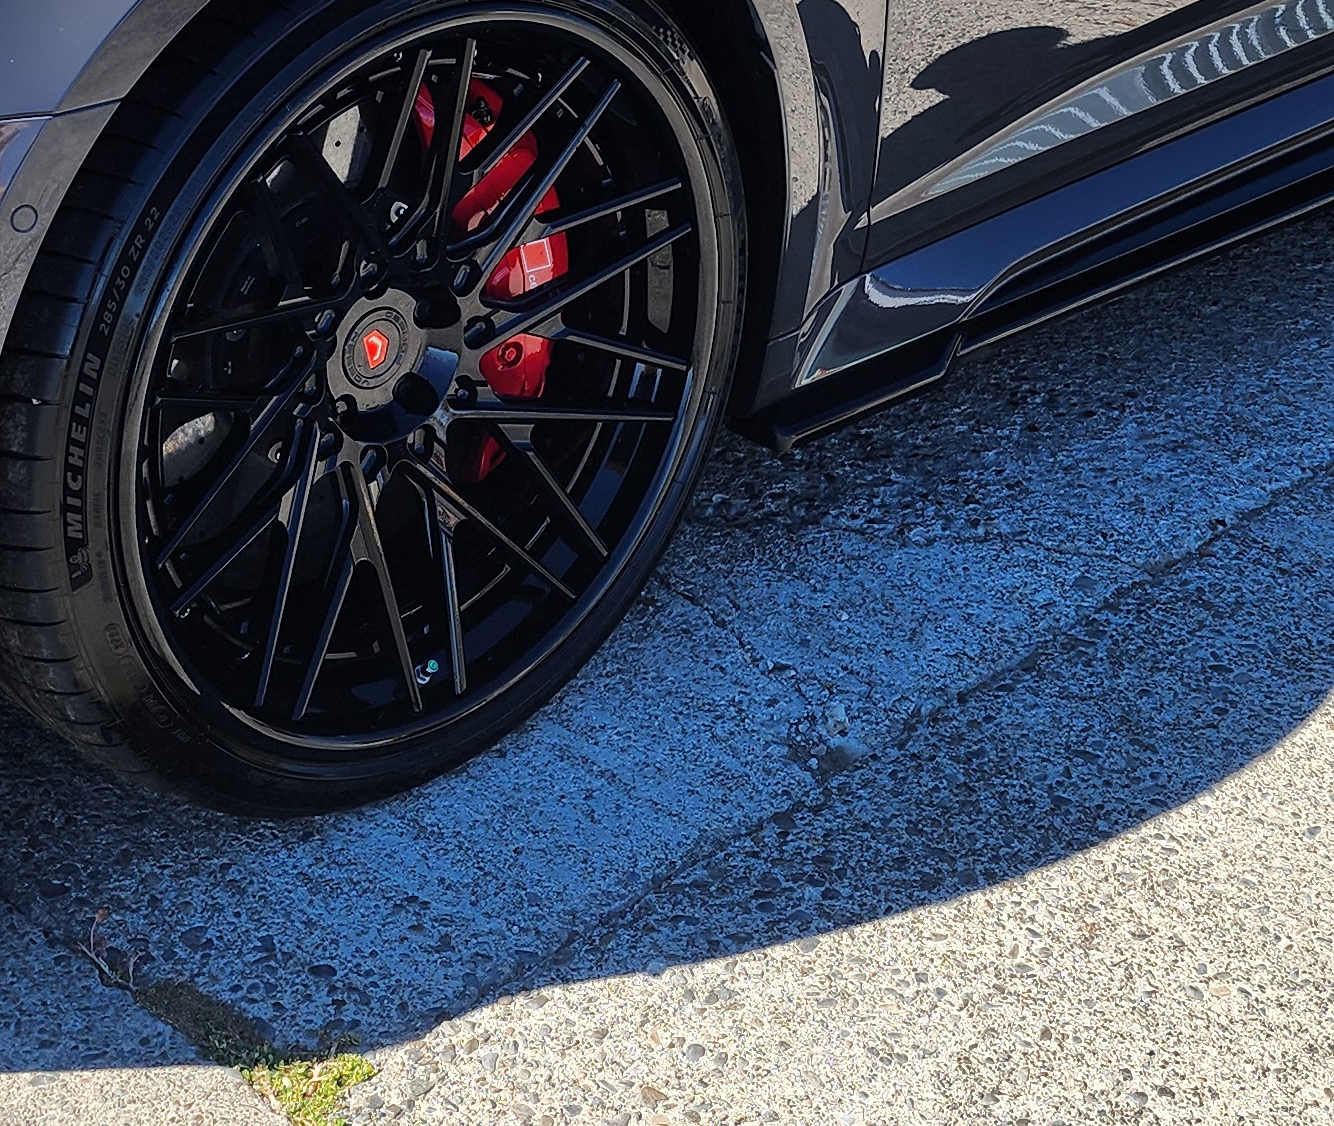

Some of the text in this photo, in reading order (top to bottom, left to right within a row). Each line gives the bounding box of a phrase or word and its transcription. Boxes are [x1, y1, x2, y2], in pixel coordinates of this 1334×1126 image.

[66, 206, 160, 539] MICHELIN 285/30 ZR 22
